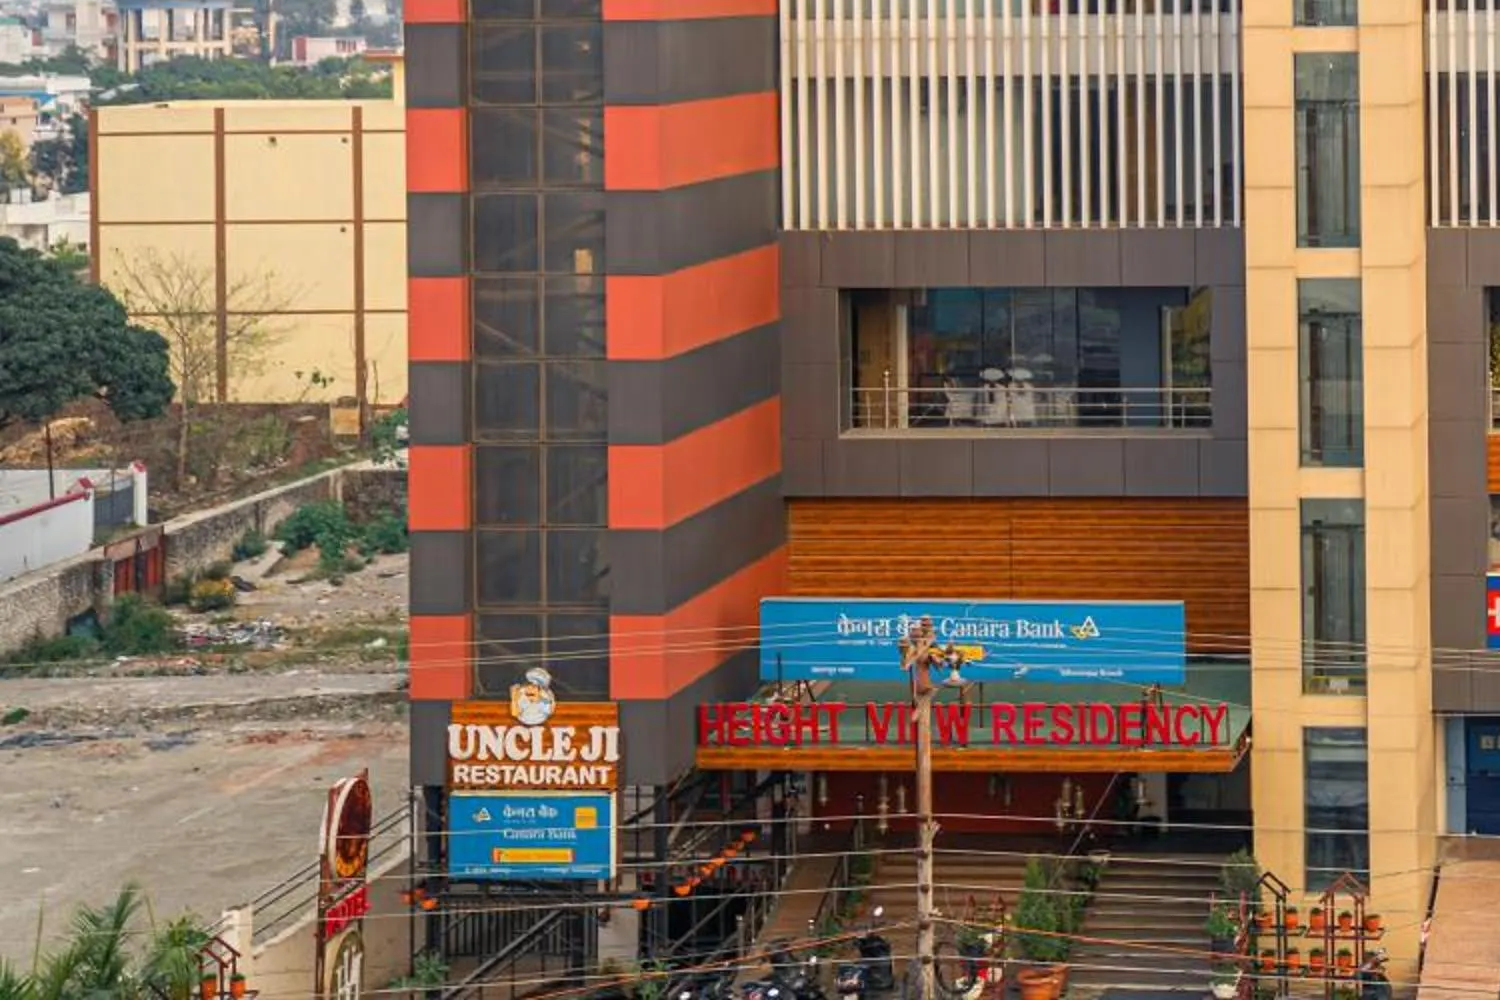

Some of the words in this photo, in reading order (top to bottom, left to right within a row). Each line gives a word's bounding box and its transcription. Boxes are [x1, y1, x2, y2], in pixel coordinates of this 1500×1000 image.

[940, 617, 1009, 638] Canara
[1016, 619, 1065, 638] Bank
[699, 702, 847, 746] HEIGHT
[990, 702, 1228, 747] RESIDENCY
[448, 724, 576, 762] UNCLE
[580, 727, 620, 762] JI
[453, 765, 612, 785] RESTAURANT
